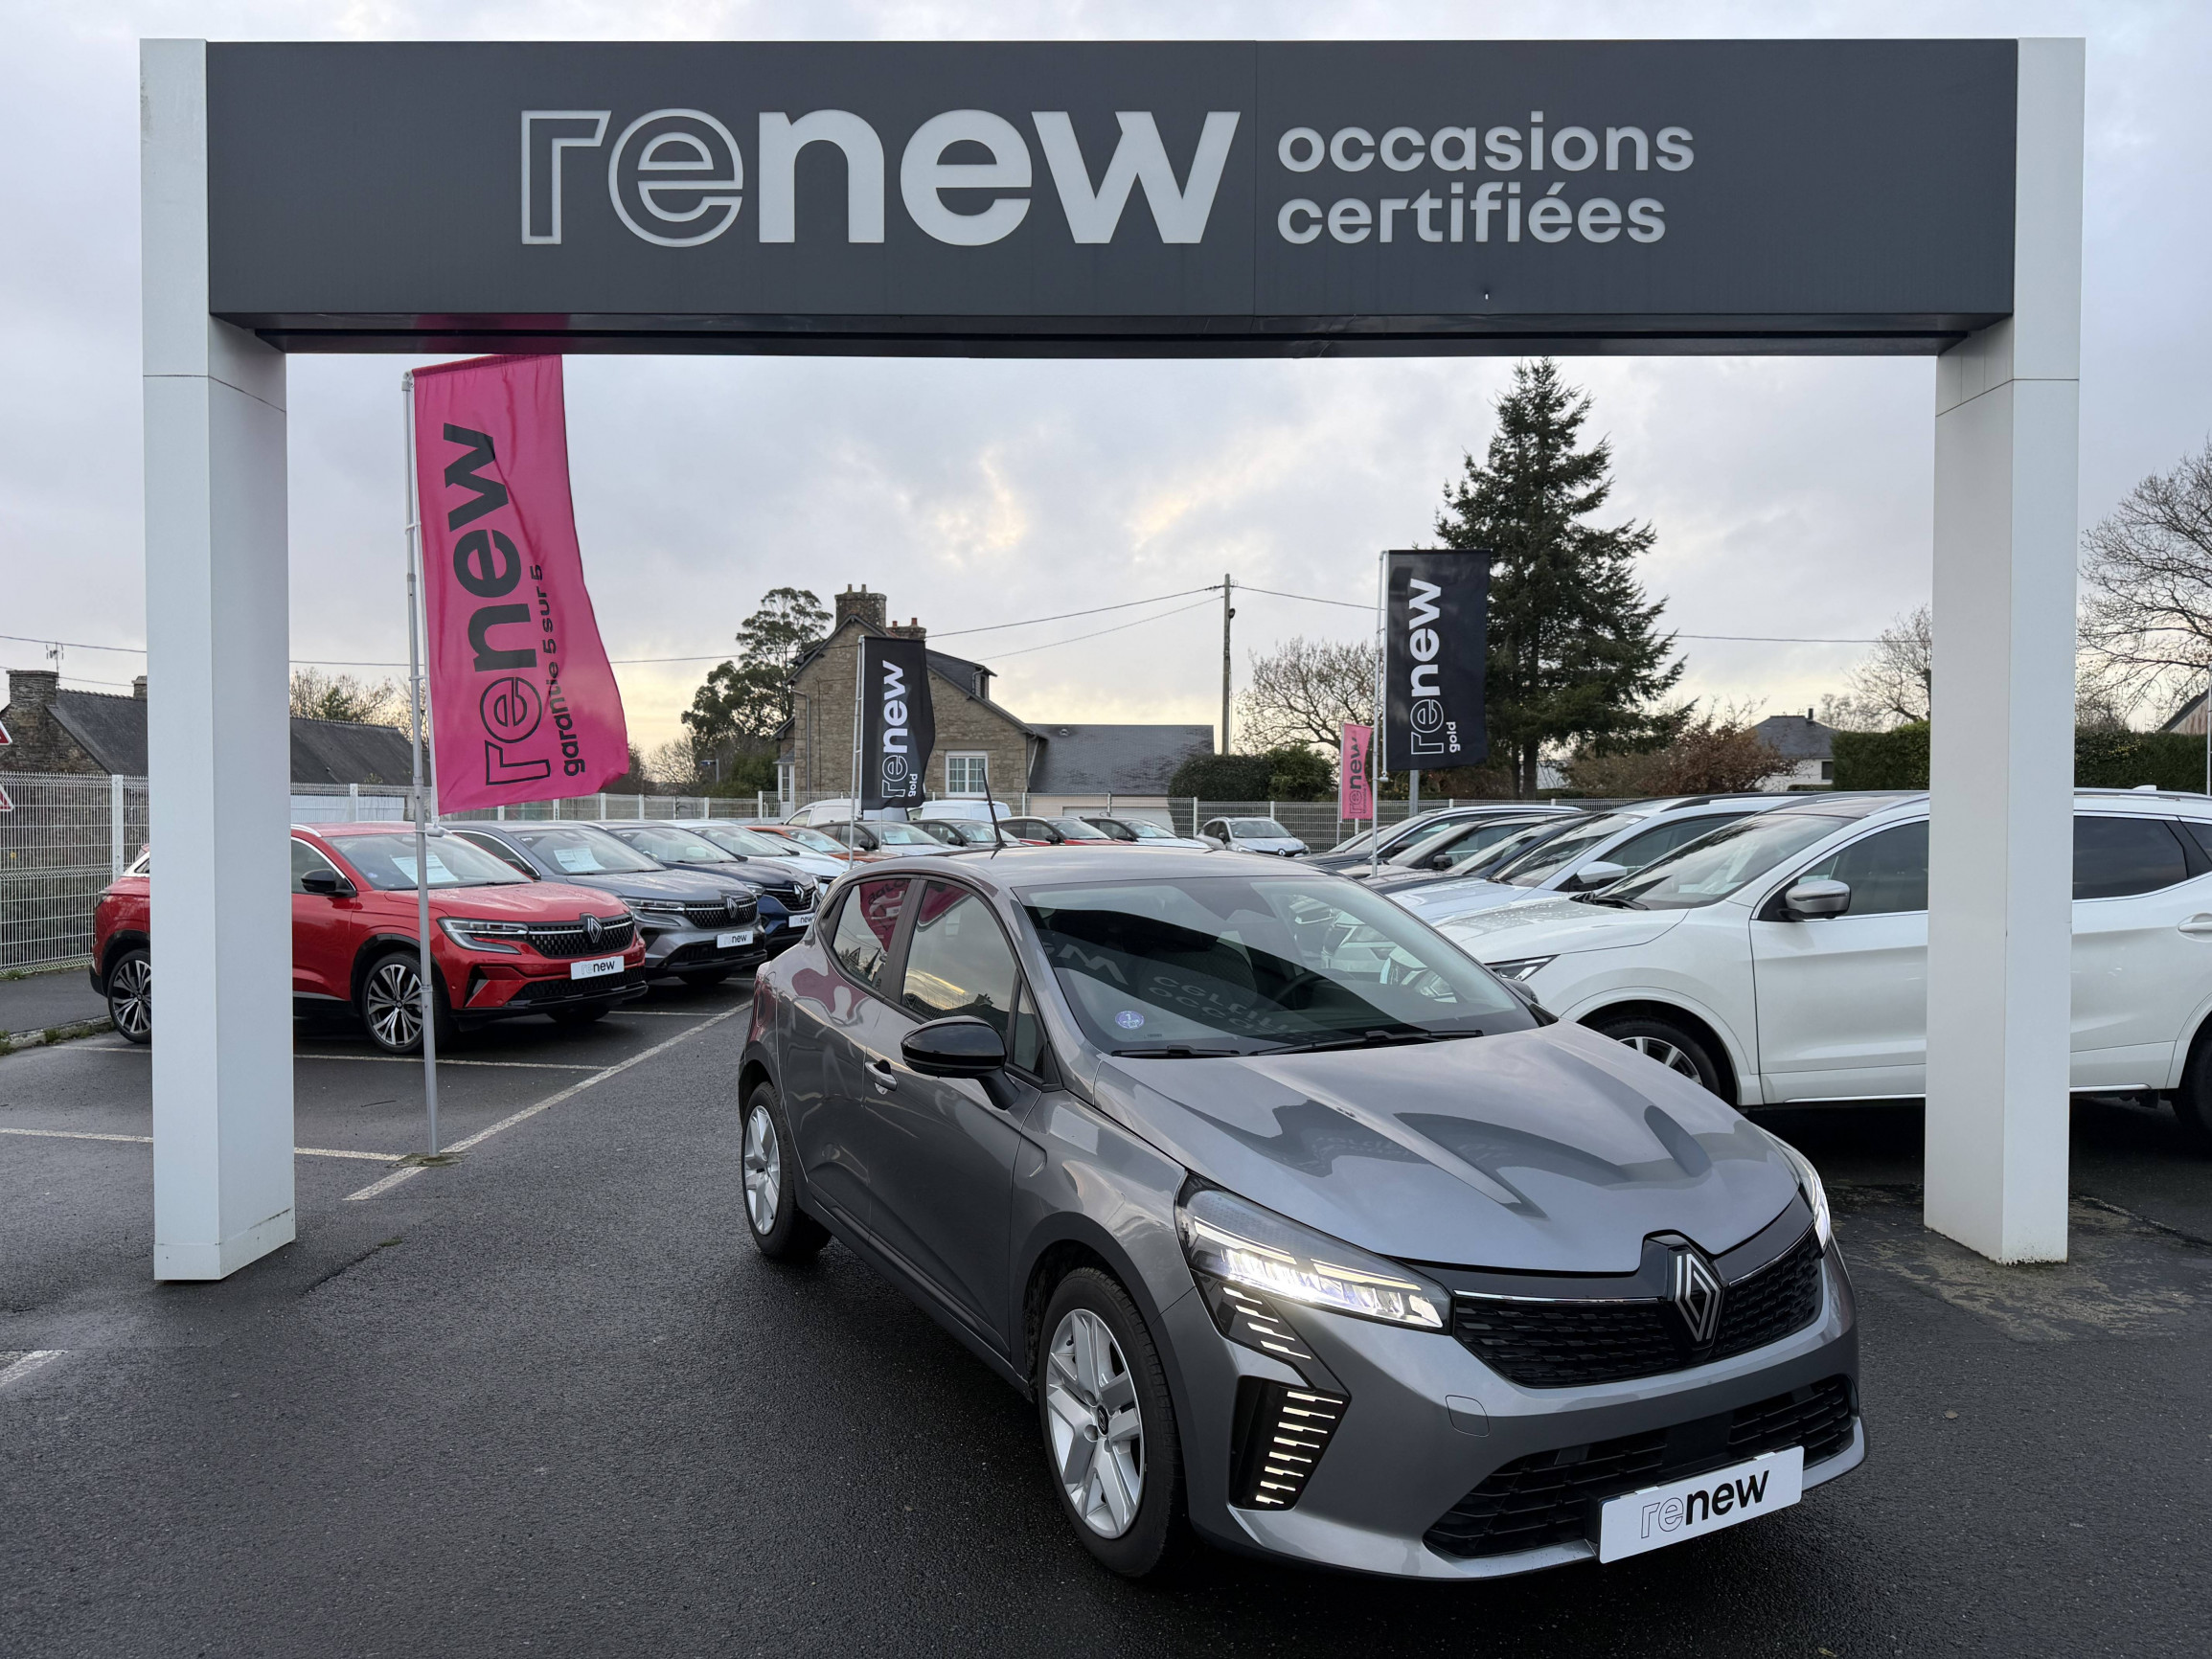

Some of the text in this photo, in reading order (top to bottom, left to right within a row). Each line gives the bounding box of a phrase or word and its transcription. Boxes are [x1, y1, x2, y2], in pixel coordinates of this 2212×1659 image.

[521, 107, 1242, 247] renew
[1277, 110, 1695, 172] occasions
[1277, 181, 1666, 244] certifiées
[443, 422, 552, 785] renew
[530, 564, 585, 777] garantie 5 sur 5
[1408, 578, 1445, 755] renew
[881, 659, 908, 799] renew
[1446, 721, 1461, 754] gold
[907, 773, 919, 798] gold
[1349, 737, 1362, 814] renew
[581, 960, 615, 976] renew
[1640, 1469, 1770, 1539] renew
